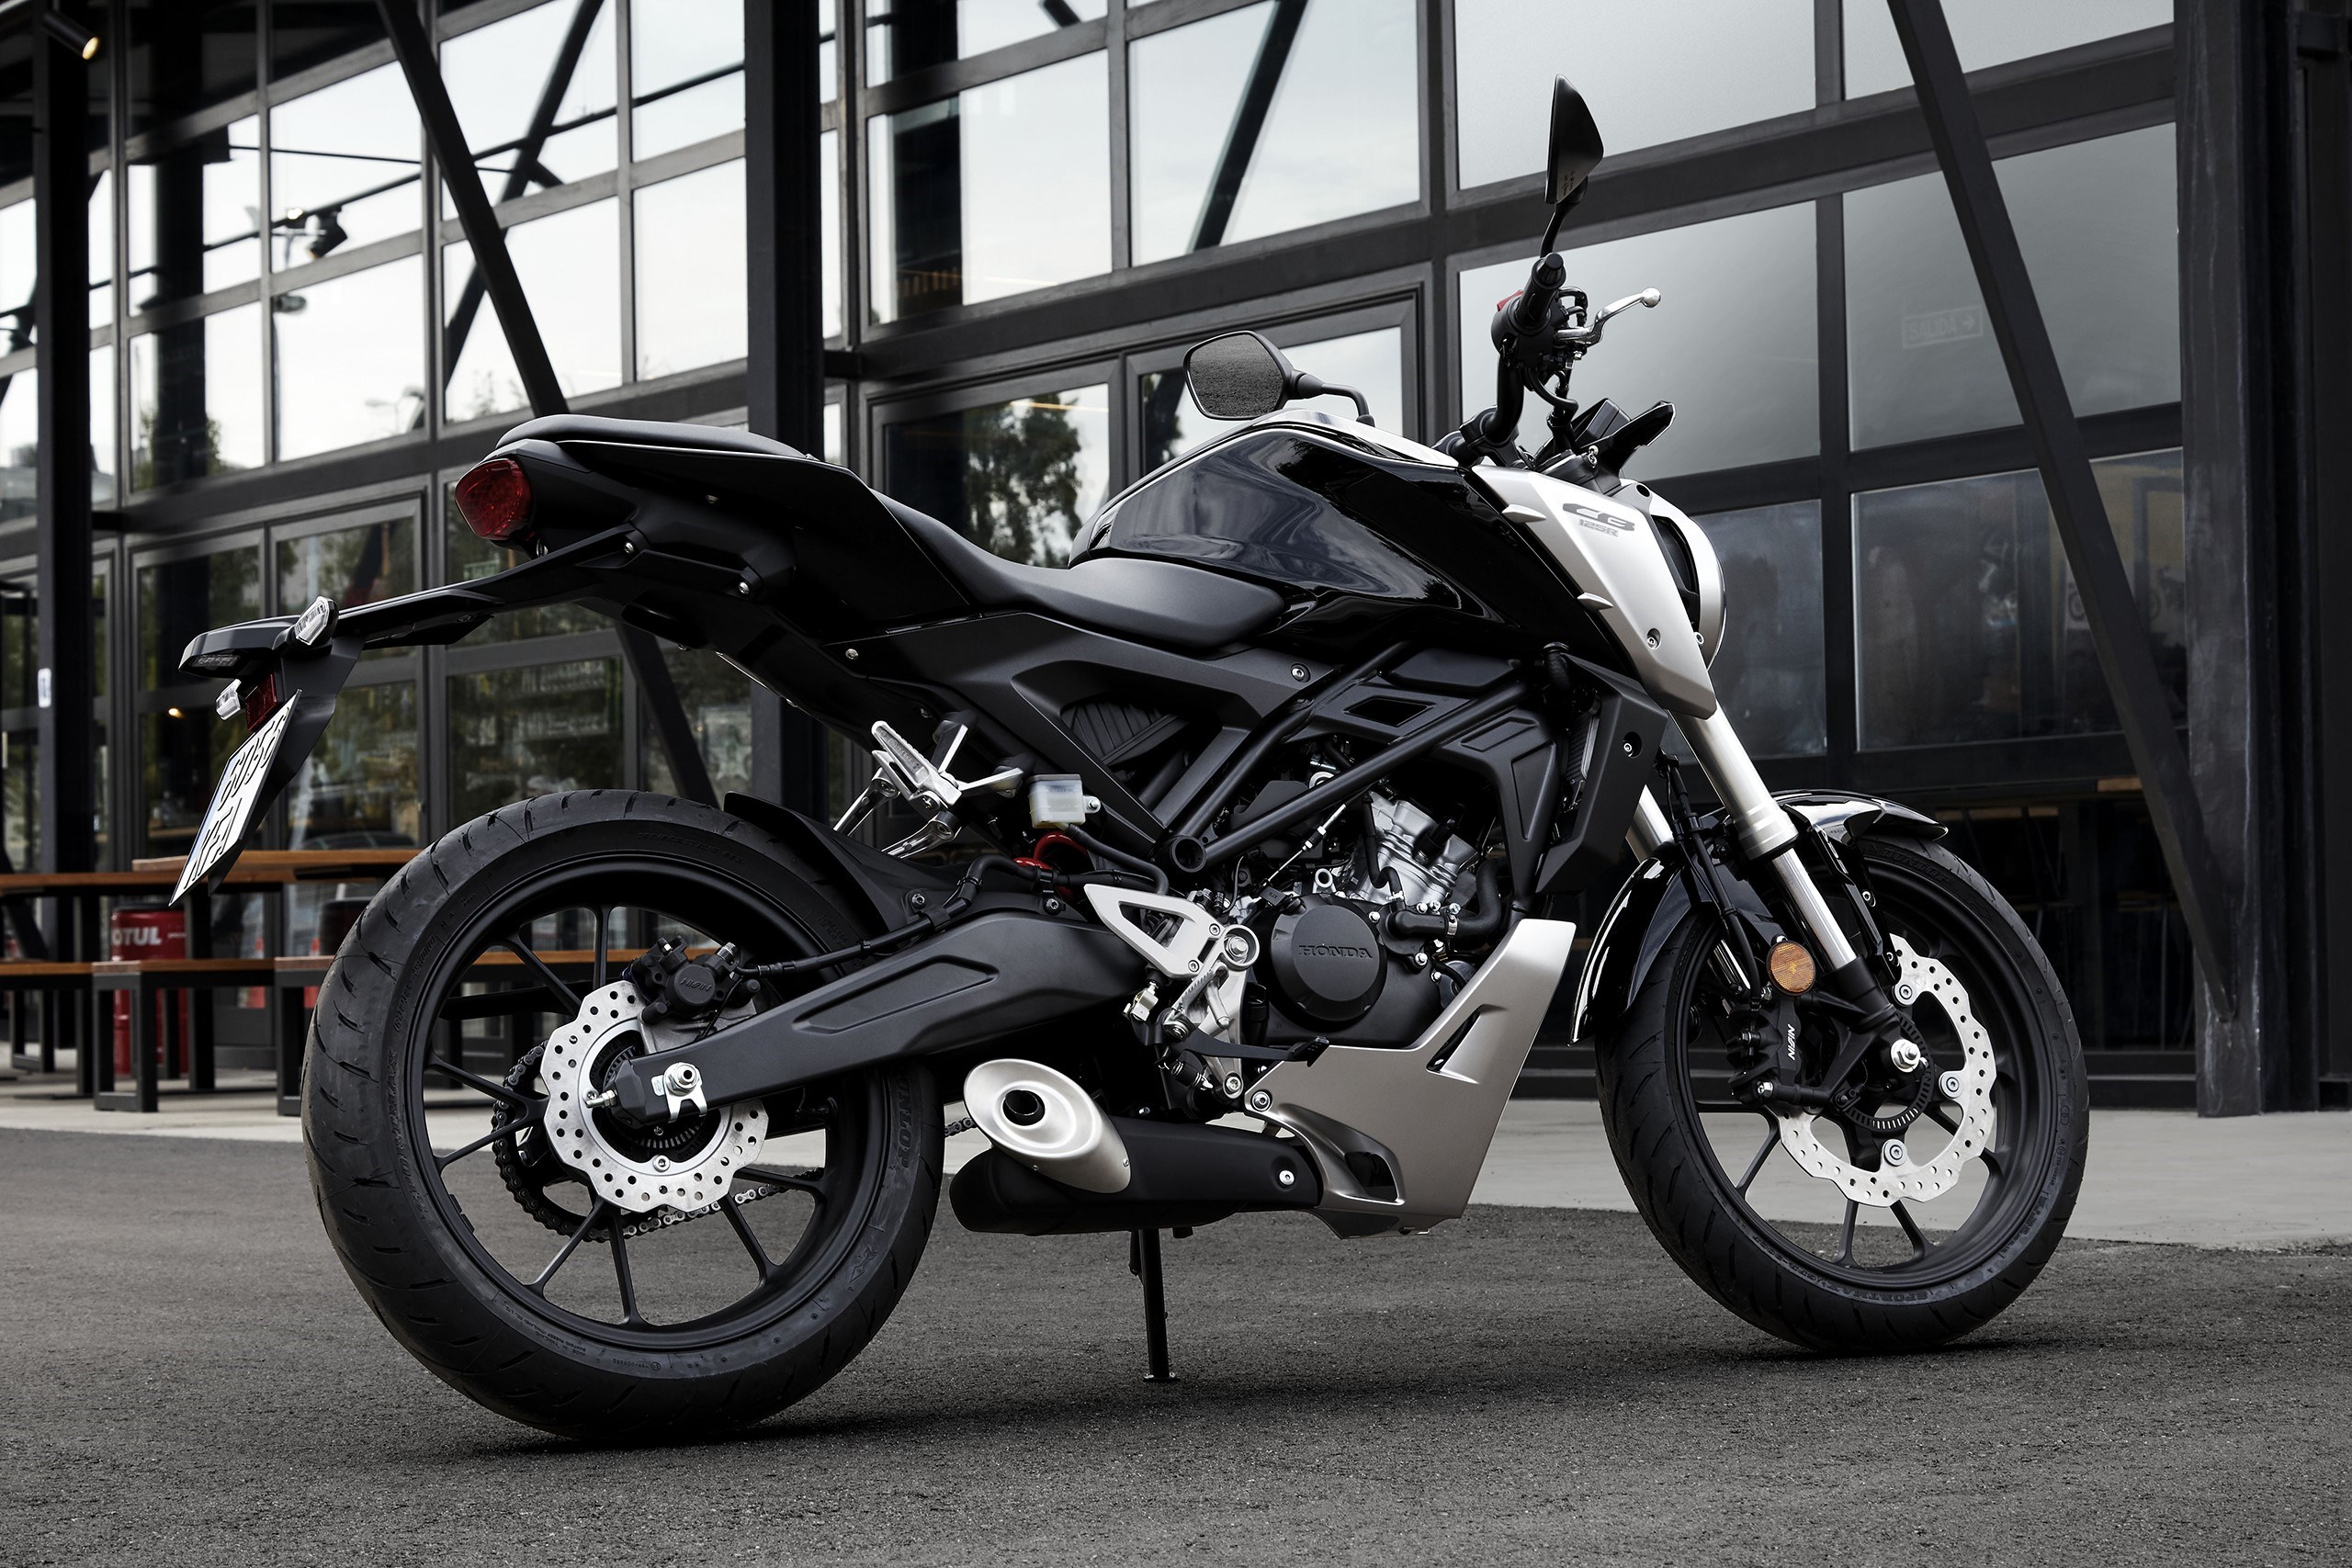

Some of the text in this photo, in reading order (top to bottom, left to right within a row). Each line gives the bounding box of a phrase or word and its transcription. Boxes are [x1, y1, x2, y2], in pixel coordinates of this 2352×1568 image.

[1562, 502, 1635, 532] CB
[1578, 518, 1619, 537] 125R
[112, 926, 162, 946] OTUL
[1298, 945, 1374, 959] HONDA
[898, 1071, 911, 1168] UNLOP
